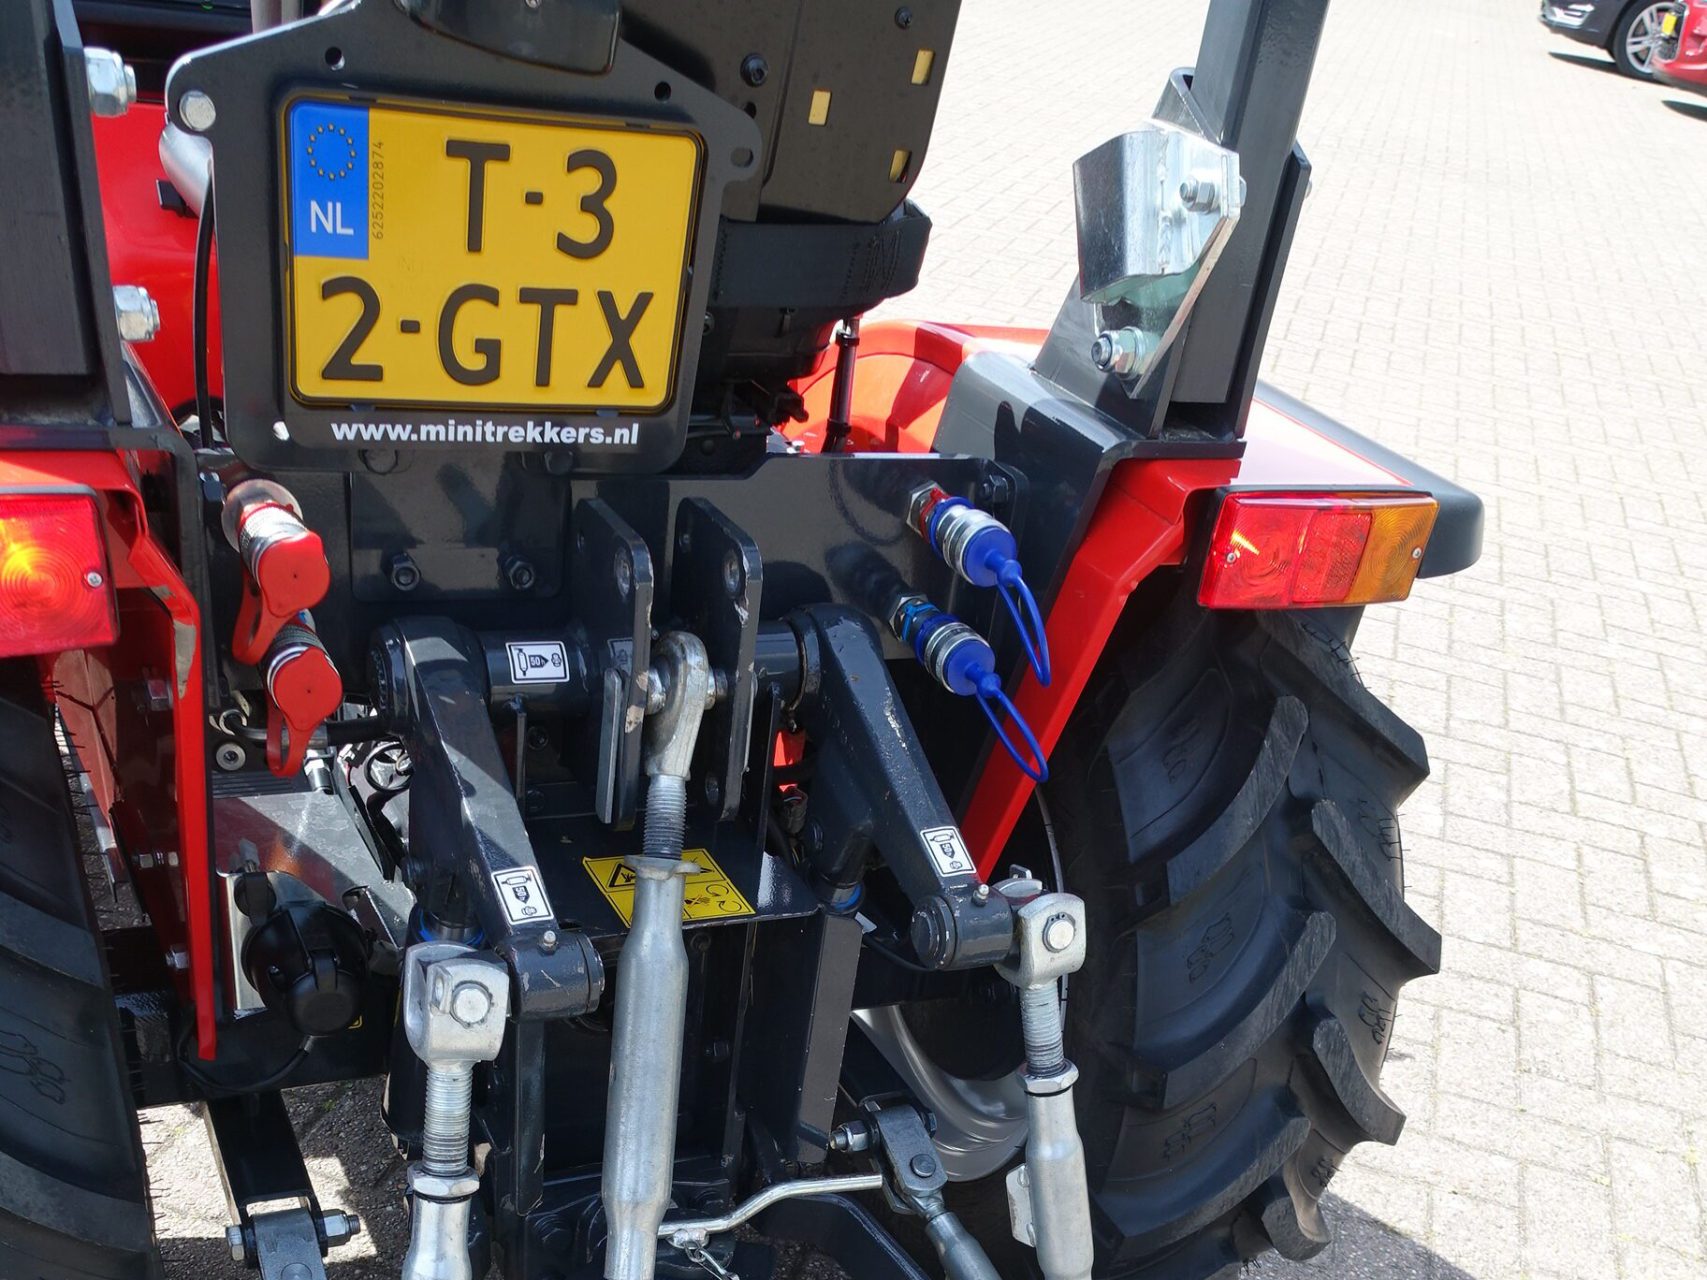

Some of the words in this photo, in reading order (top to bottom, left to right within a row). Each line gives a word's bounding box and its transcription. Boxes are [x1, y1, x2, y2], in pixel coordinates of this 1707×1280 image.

[310, 200, 355, 236] NL
[372, 141, 385, 240] 6252202874
[446, 139, 617, 260] T-3
[321, 275, 655, 388] 2-GTX
[331, 420, 639, 444] www.minitrekkers.nl
